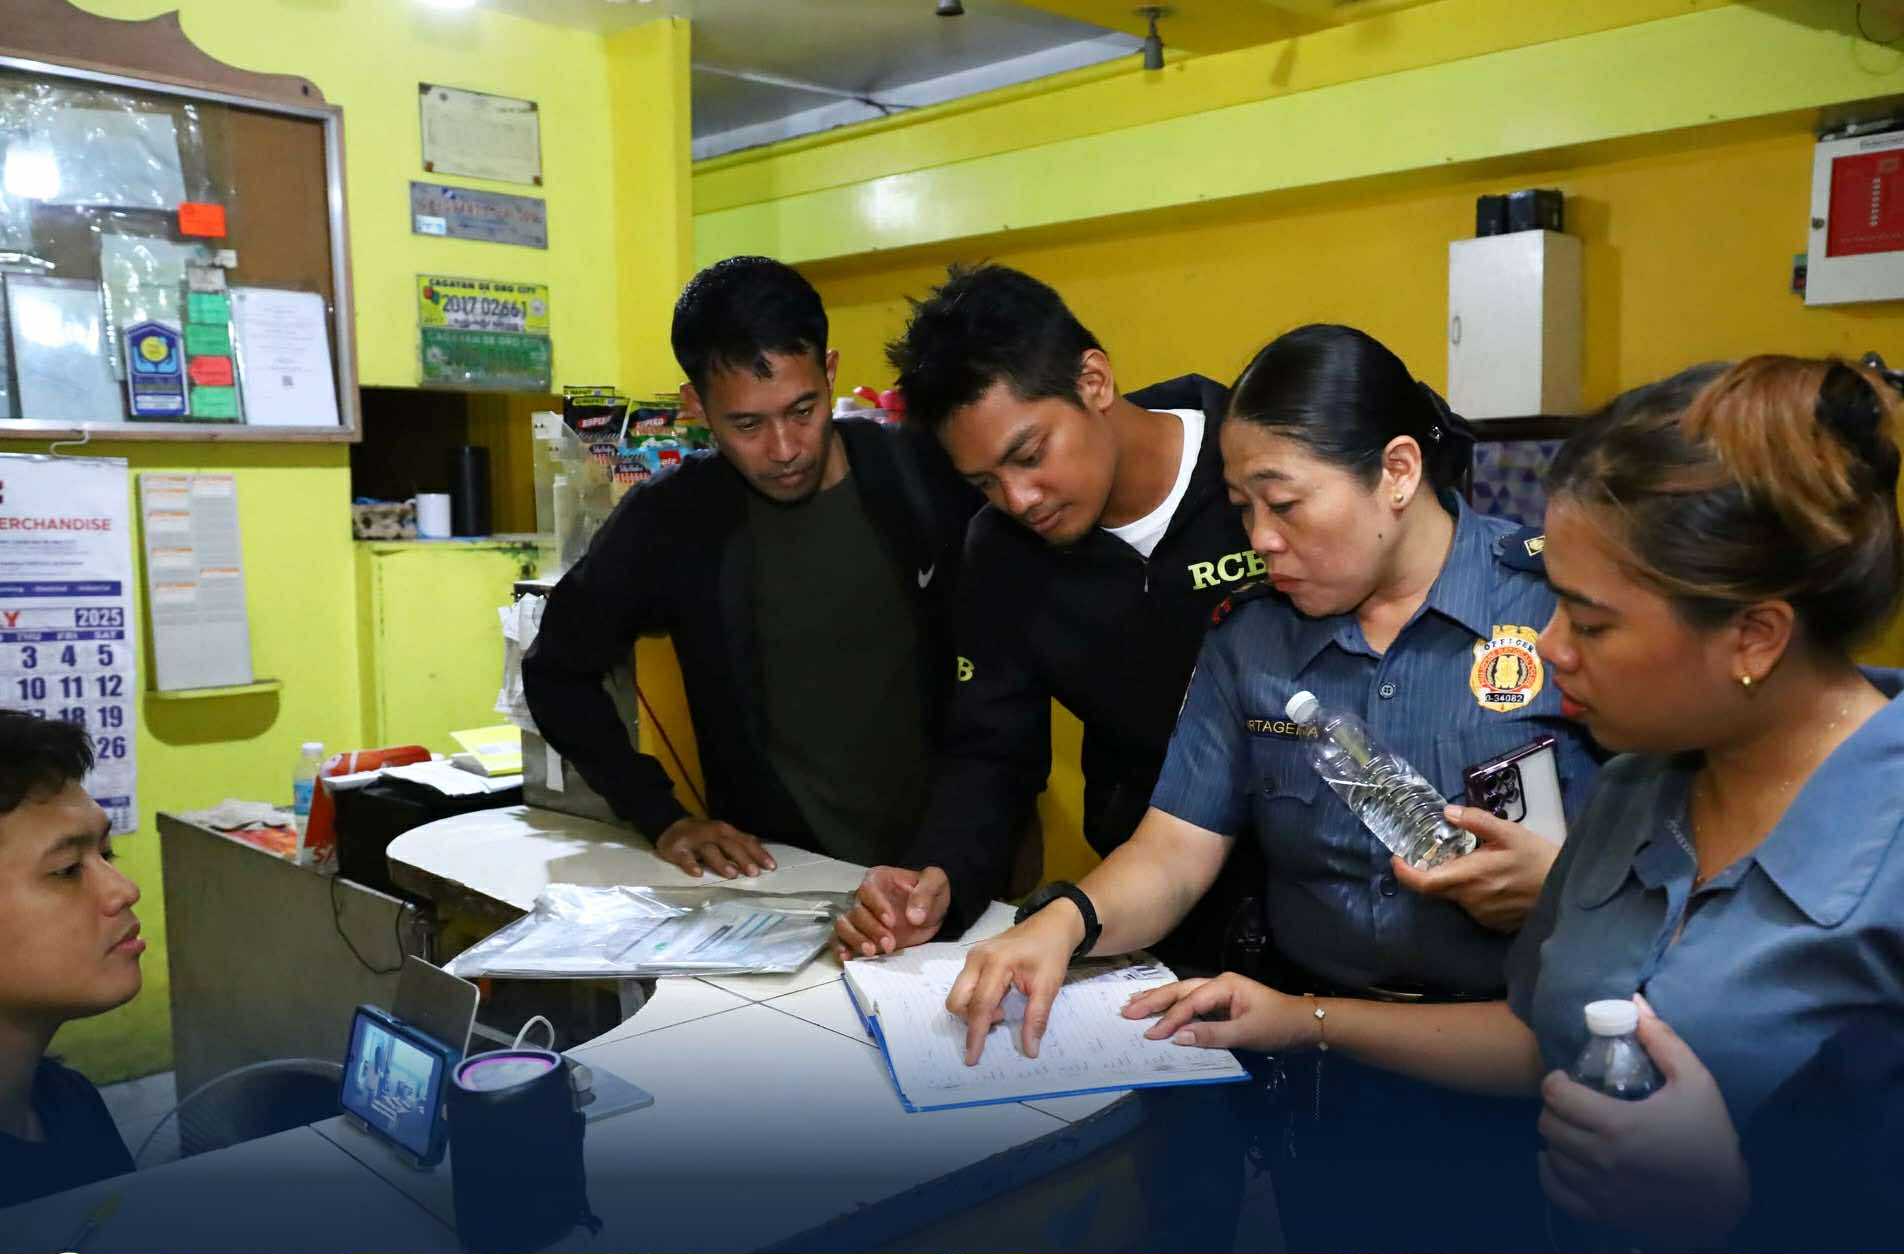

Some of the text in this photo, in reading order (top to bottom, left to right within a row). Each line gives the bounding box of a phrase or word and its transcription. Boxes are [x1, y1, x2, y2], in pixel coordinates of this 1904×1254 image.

[78, 610, 121, 626] 2025
[21, 644, 114, 669] 3 4 5
[1484, 638, 1534, 652] OFFICER
[16, 674, 123, 700] 10 11 12
[97, 705, 123, 728] 19
[97, 736, 126, 759] 26
